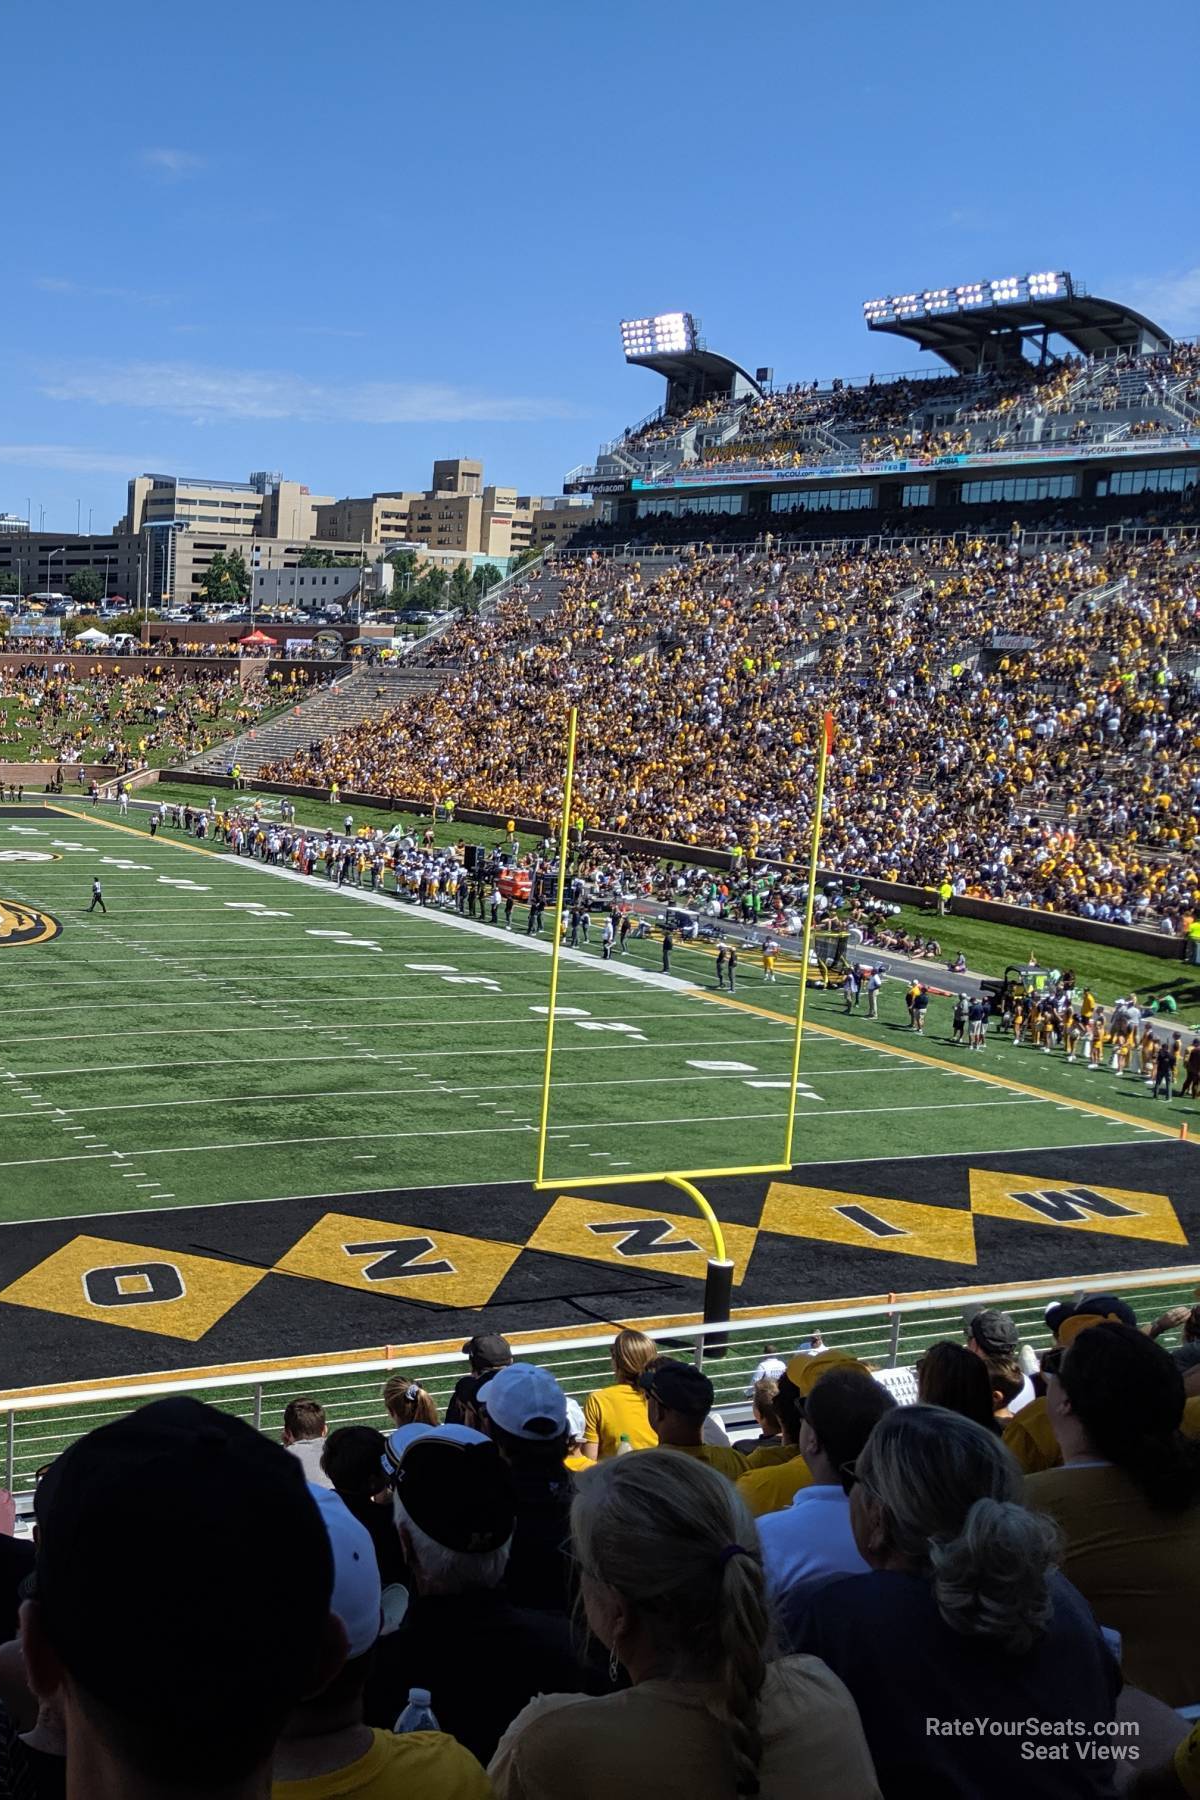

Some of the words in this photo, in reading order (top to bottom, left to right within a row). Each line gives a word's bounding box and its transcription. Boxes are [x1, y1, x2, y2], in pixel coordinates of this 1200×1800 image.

[869, 465, 898, 473] UNITED
[587, 484, 625, 494] Mediacom
[404, 963, 502, 985] 30
[528, 1006, 644, 1032] 20
[684, 1059, 815, 1089] 10
